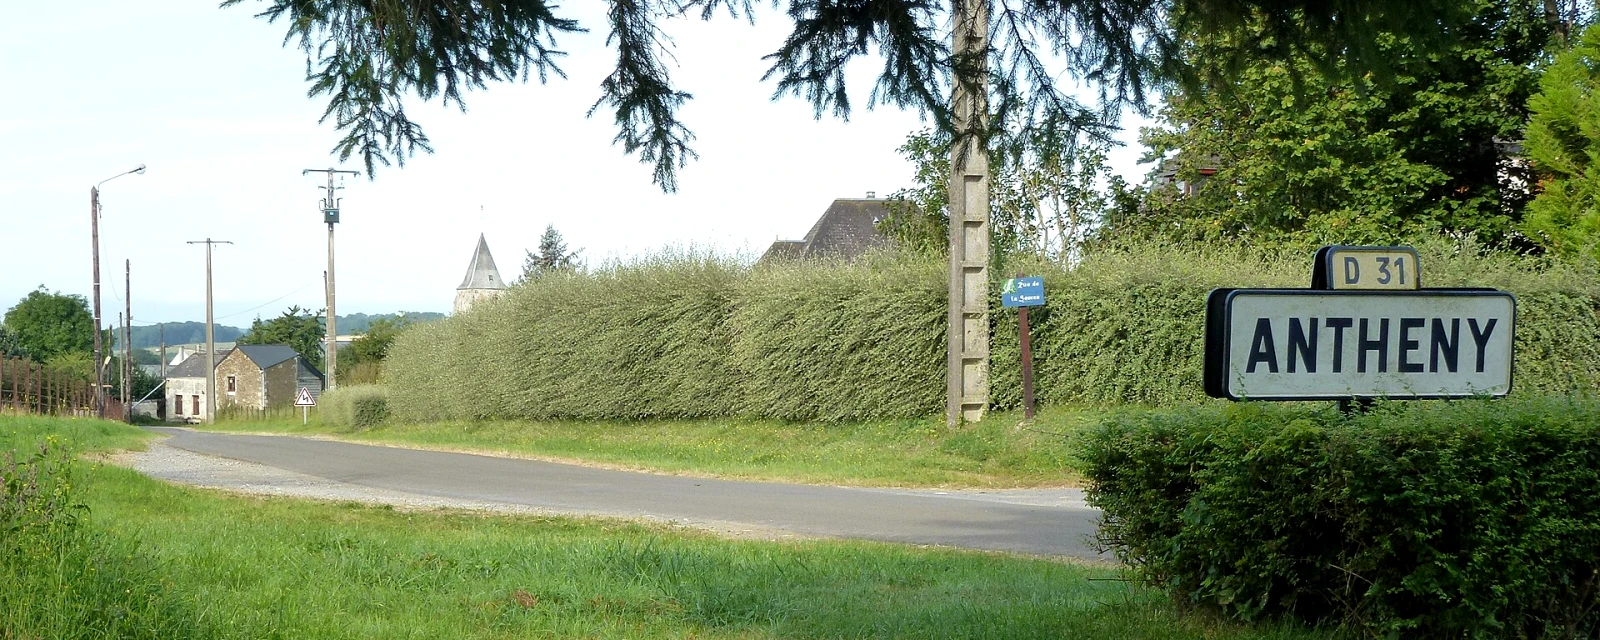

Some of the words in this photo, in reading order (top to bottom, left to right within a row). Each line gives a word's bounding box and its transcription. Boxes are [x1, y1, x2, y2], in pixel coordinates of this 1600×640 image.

[1344, 257, 1360, 285] D
[1375, 256, 1405, 285] 31
[1246, 317, 1498, 373] ANTHENY
